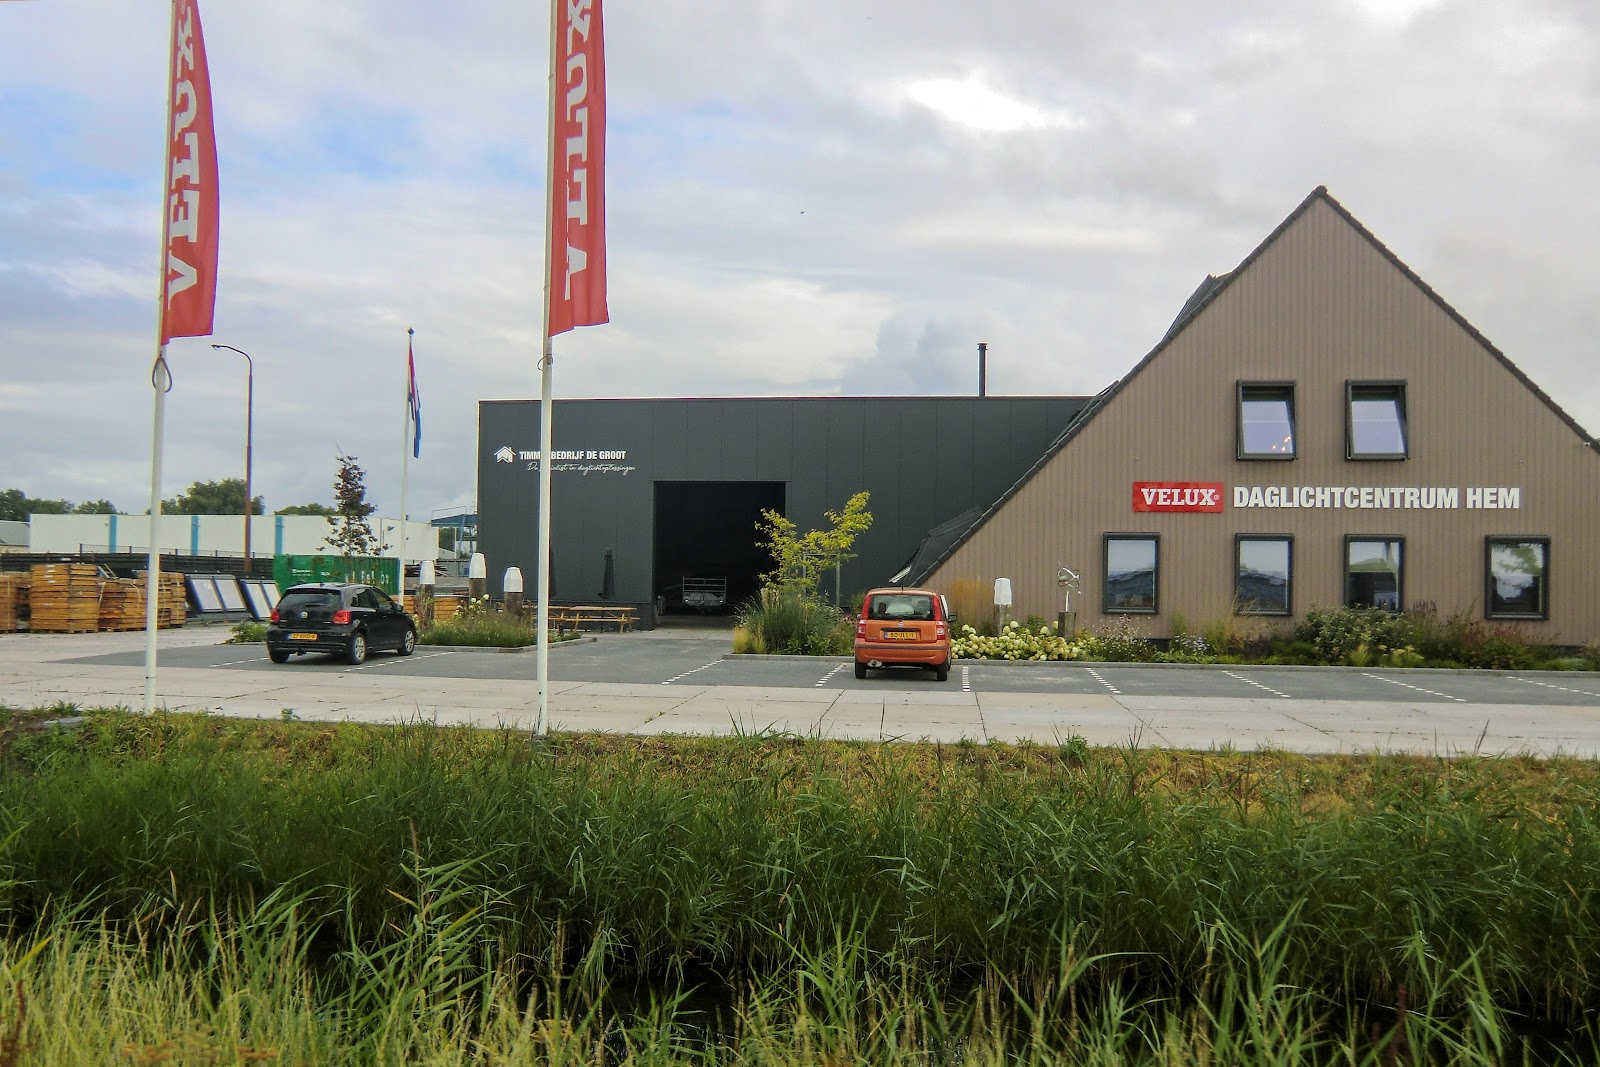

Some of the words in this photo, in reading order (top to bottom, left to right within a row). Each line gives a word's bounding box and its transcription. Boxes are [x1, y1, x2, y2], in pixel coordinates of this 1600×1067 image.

[519, 451, 584, 460] TIMMBEDRIJF
[586, 451, 598, 460] DE
[599, 451, 627, 460] GROOT
[1233, 486, 1459, 509] DAGLICHTCENTRUM
[1466, 487, 1520, 509] HEM
